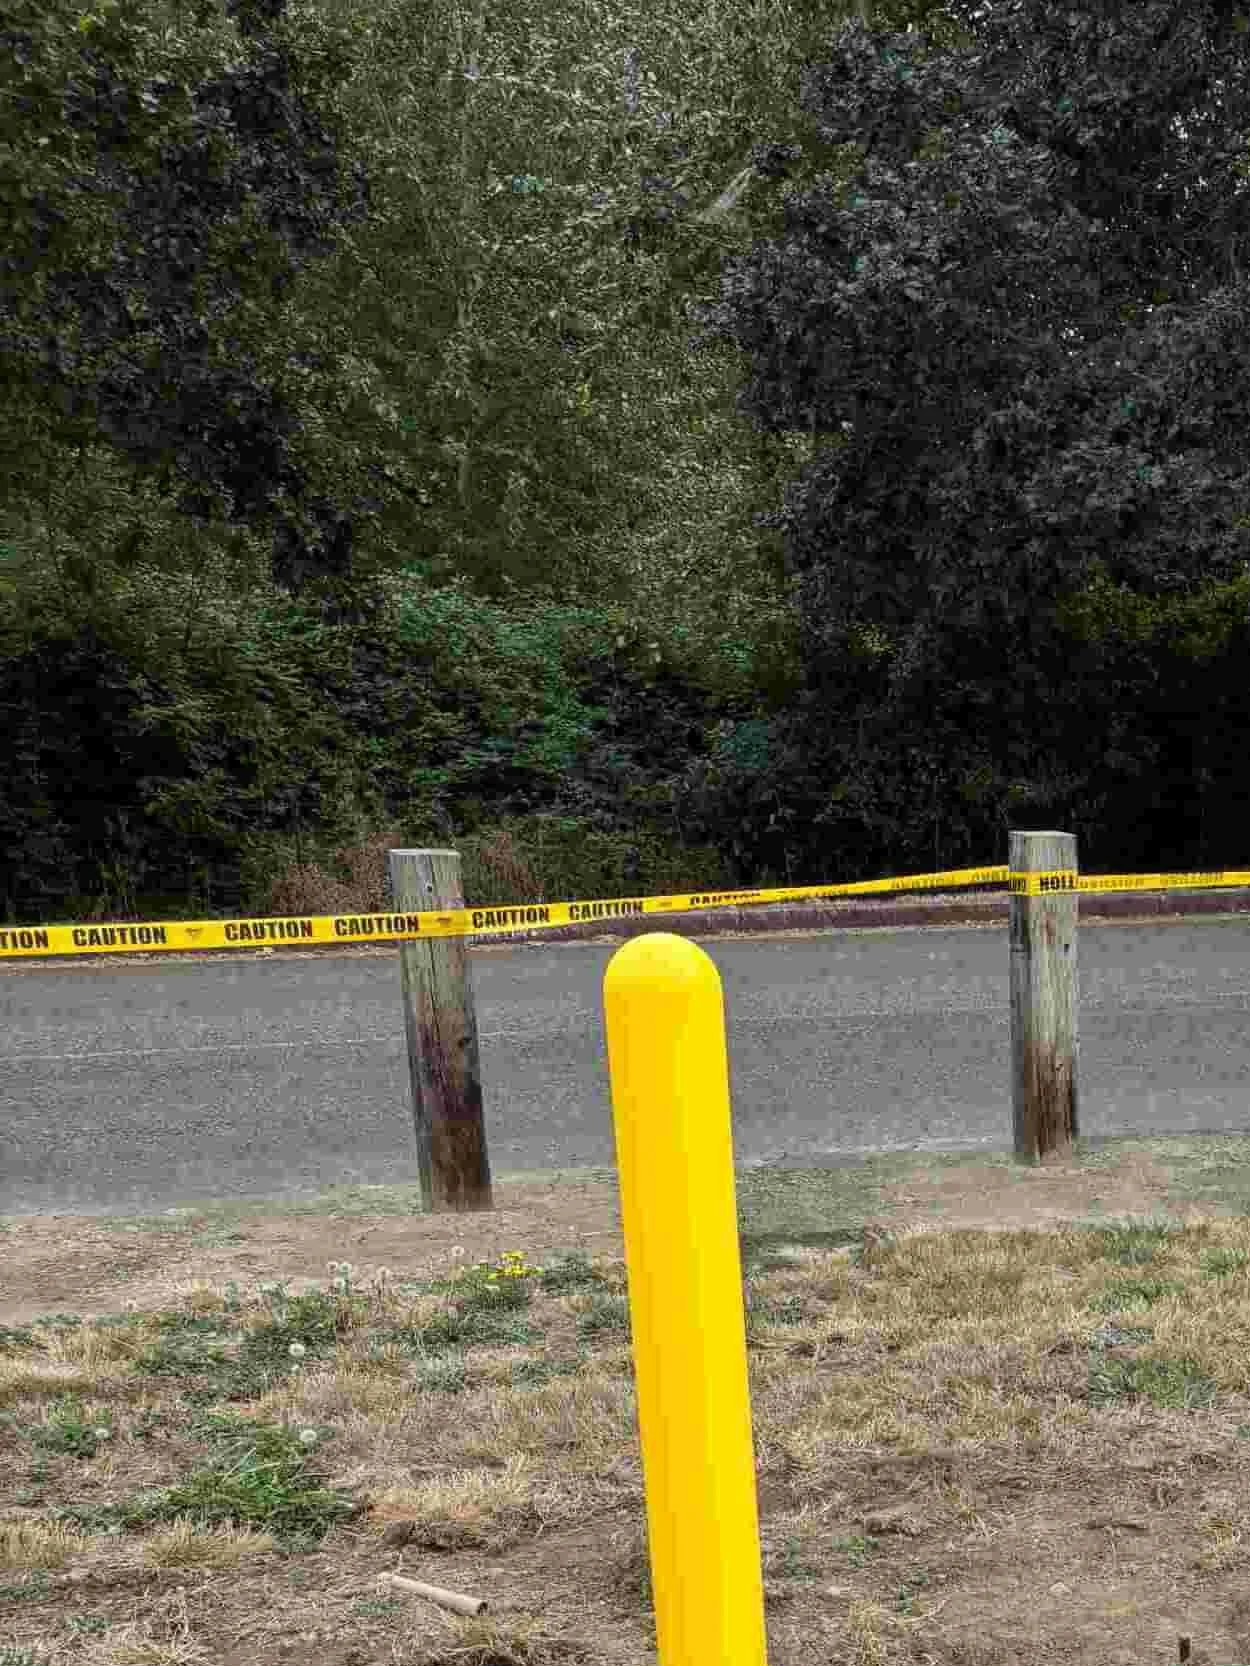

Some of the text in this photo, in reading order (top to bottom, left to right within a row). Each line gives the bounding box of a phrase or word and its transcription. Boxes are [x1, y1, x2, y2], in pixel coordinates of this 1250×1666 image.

[72, 927, 167, 946] CAUTION
[224, 920, 313, 941] CAUTION
[334, 915, 420, 936] CAUTION
[472, 907, 550, 929] CAUTION
[568, 900, 643, 921] CAUTION
